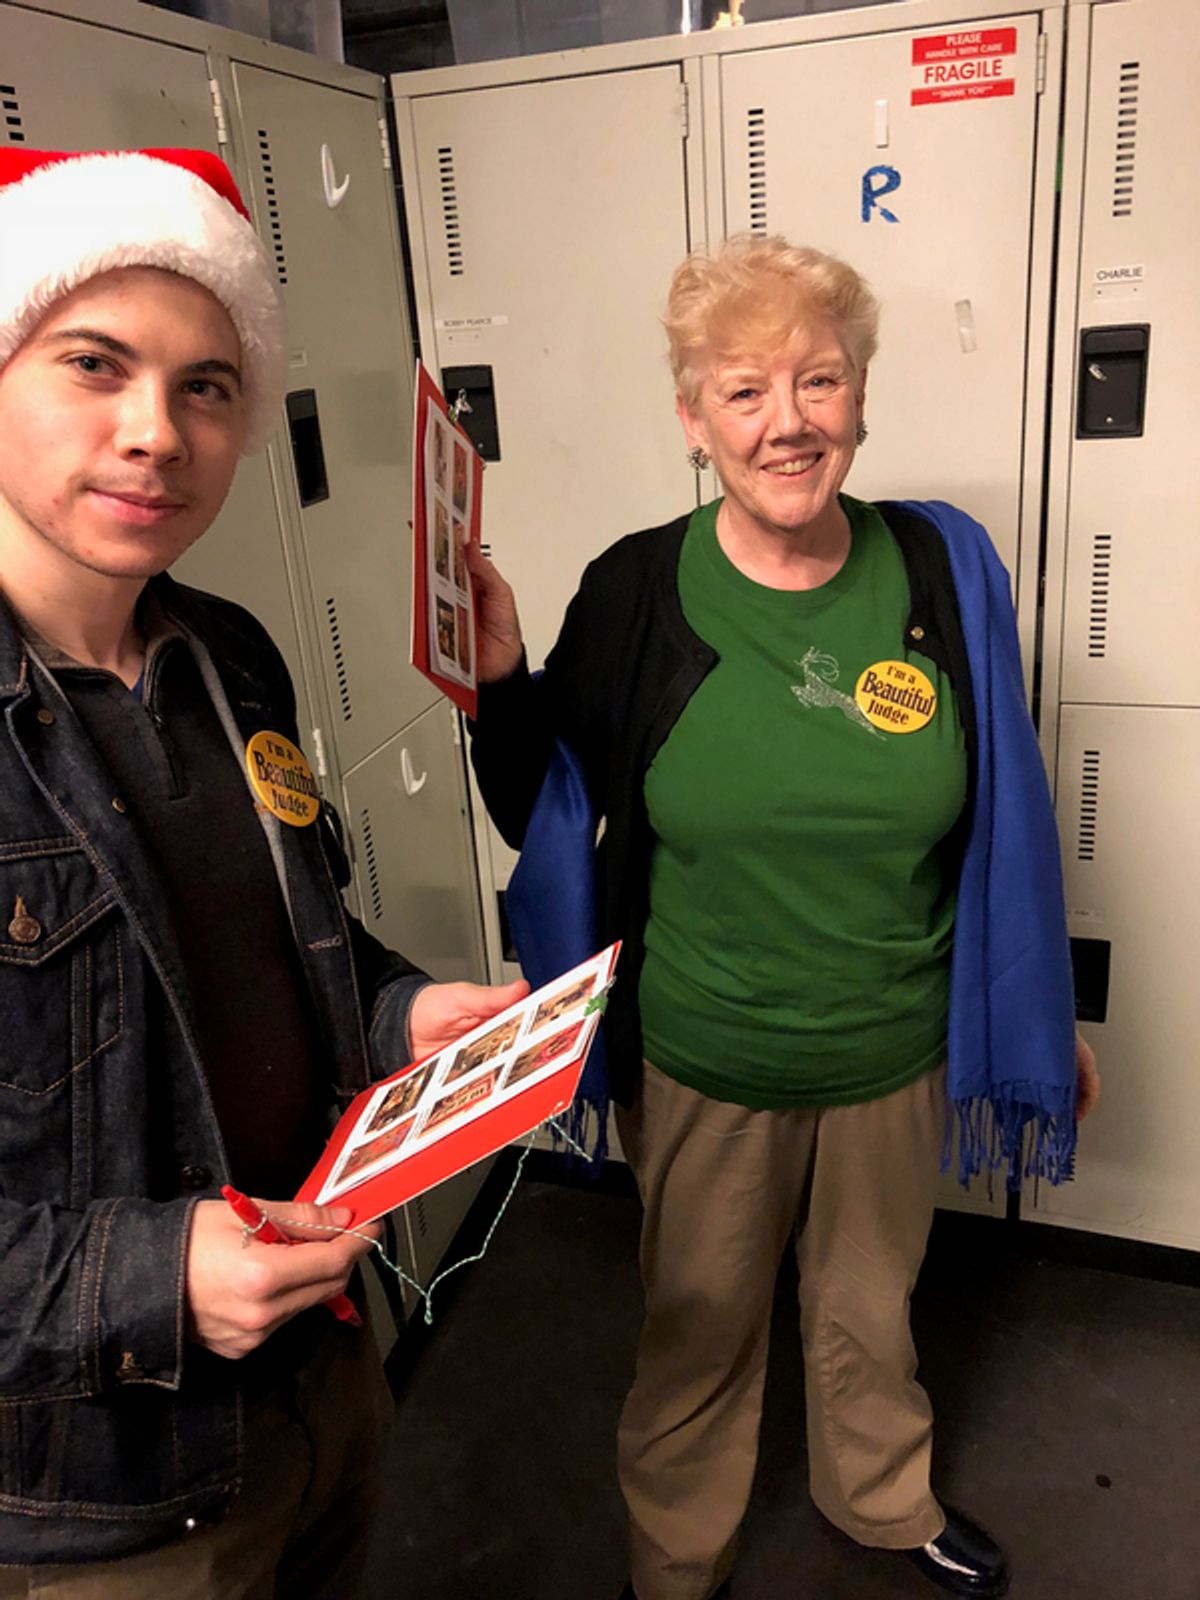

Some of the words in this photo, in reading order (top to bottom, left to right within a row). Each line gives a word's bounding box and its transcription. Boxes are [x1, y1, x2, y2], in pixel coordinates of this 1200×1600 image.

[925, 48, 956, 59] HANDLE
[980, 43, 1003, 53] CARE
[946, 32, 981, 45] PLEASE
[924, 59, 1003, 84] FRAGILE
[862, 165, 902, 223] R
[1096, 266, 1143, 280] CHARLIE
[886, 665, 906, 680] I'm
[908, 674, 916, 685] a
[861, 671, 935, 716] Beautiful
[868, 699, 909, 725] Judge
[271, 788, 309, 818] Judge
